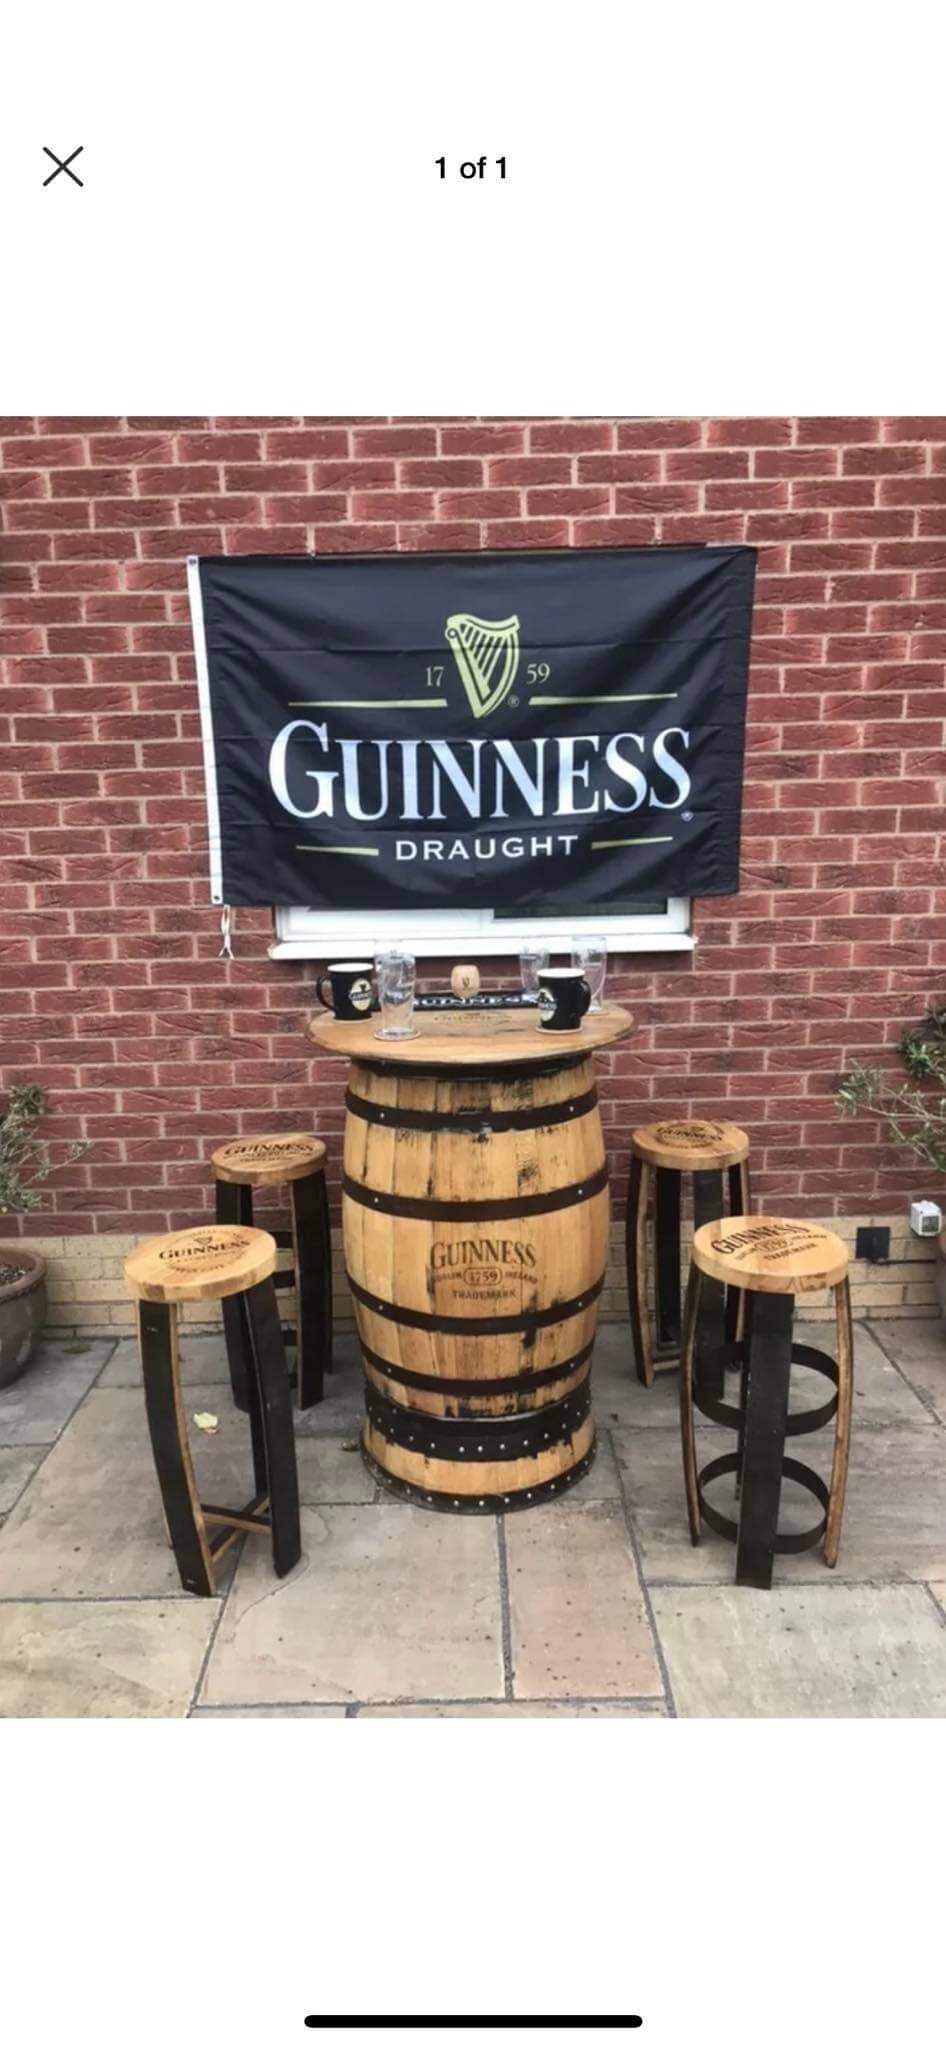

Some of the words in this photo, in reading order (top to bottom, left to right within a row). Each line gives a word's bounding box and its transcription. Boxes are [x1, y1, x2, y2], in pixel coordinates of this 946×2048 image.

[425, 666, 445, 688] 17
[526, 662, 551, 685] 59
[268, 719, 692, 822] GUINNESS
[395, 835, 579, 861] DRAUGHT
[158, 1240, 251, 1260] GUINNESS
[430, 1239, 537, 1269] GUINNESS
[469, 1270, 498, 1282] 1759
[451, 1289, 517, 1300] TRADEMARK
